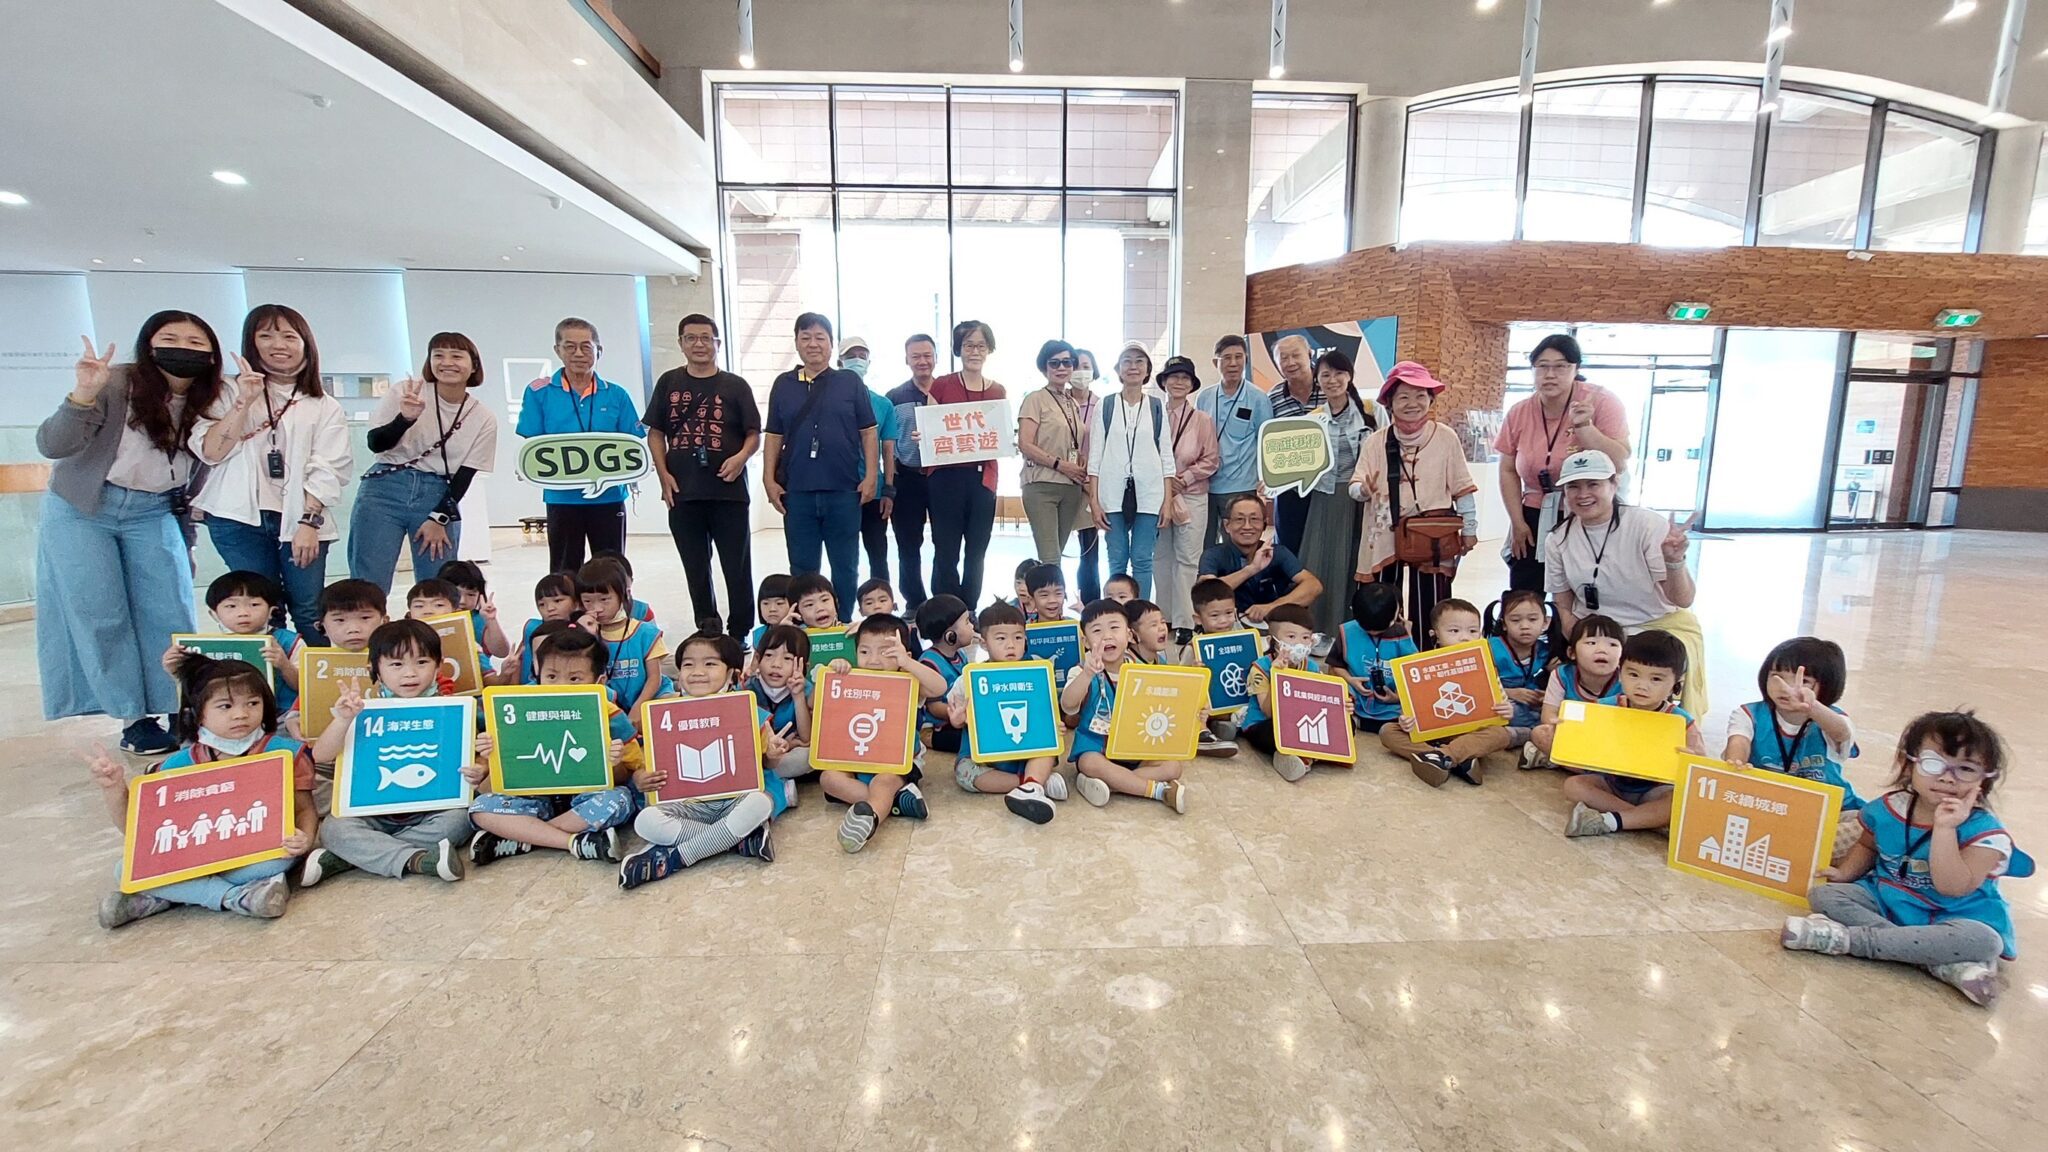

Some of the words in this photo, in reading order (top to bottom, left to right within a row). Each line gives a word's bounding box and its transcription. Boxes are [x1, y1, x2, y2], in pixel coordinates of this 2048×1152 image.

[942, 411, 986, 431] 世代
[933, 431, 999, 455] 齊藝遊
[534, 443, 644, 478] SDGs
[1273, 450, 1316, 469] 分公司
[811, 642, 844, 652] 陸地生態
[1203, 643, 1215, 660] 17
[316, 659, 329, 679] 2
[1409, 667, 1421, 683] 9
[831, 679, 842, 699] 5
[843, 688, 881, 700] 性別平等
[978, 676, 989, 695] 6
[992, 681, 1034, 693] 淨水與衛生
[1132, 678, 1143, 697] 7
[1282, 680, 1292, 697] 8
[503, 703, 517, 725] 3
[525, 710, 583, 722] 健康與福祉
[660, 710, 673, 732] 4
[677, 716, 720, 732] 優質教育
[363, 716, 385, 738] 14
[386, 719, 435, 732] 海洋生態
[155, 785, 168, 807] 1
[173, 780, 236, 803] 消除貧窮
[1697, 776, 1717, 801] 11
[1722, 790, 1789, 816] 永續城鄉
